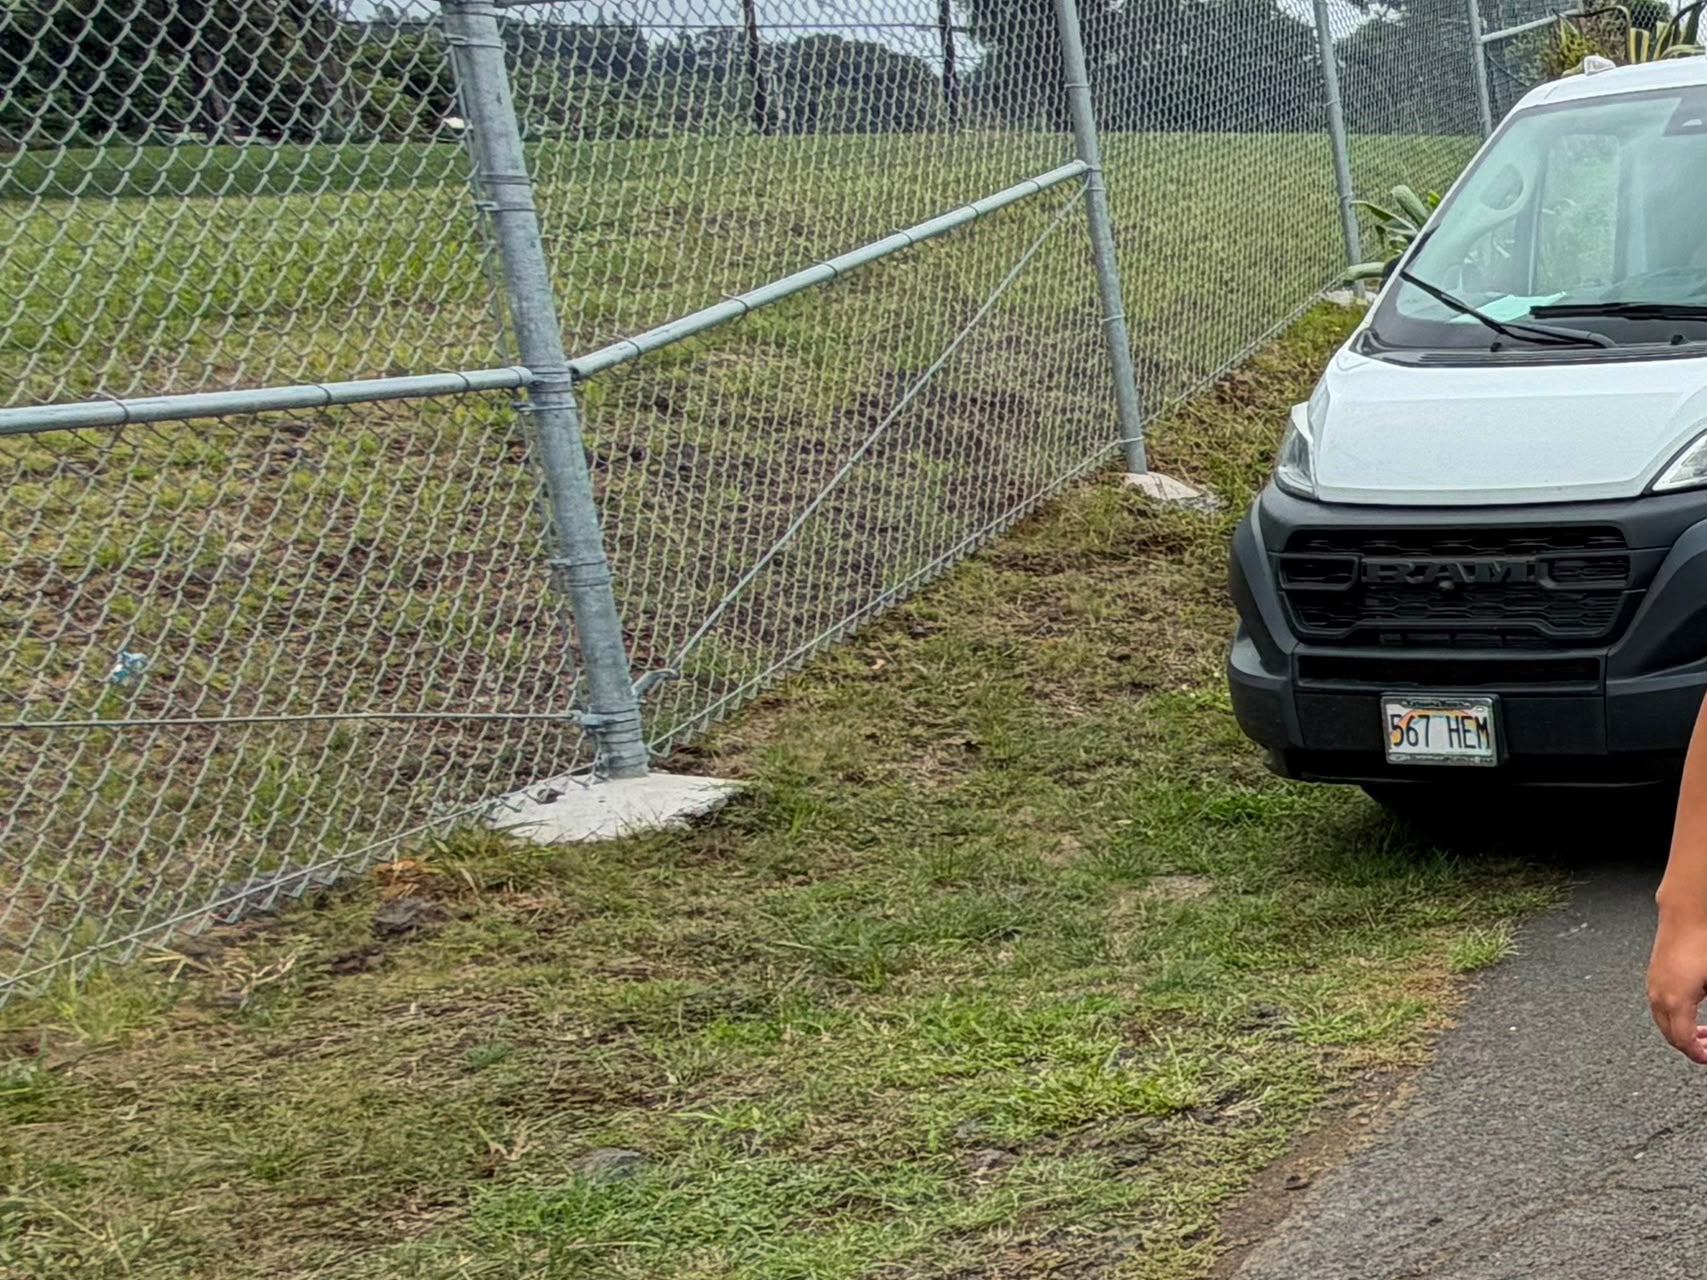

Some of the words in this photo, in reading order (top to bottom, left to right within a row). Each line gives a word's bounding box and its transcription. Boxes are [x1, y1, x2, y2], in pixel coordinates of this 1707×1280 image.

[1361, 557, 1537, 584] RAM
[1390, 714, 1431, 748] 567
[1446, 714, 1490, 750] HEM
